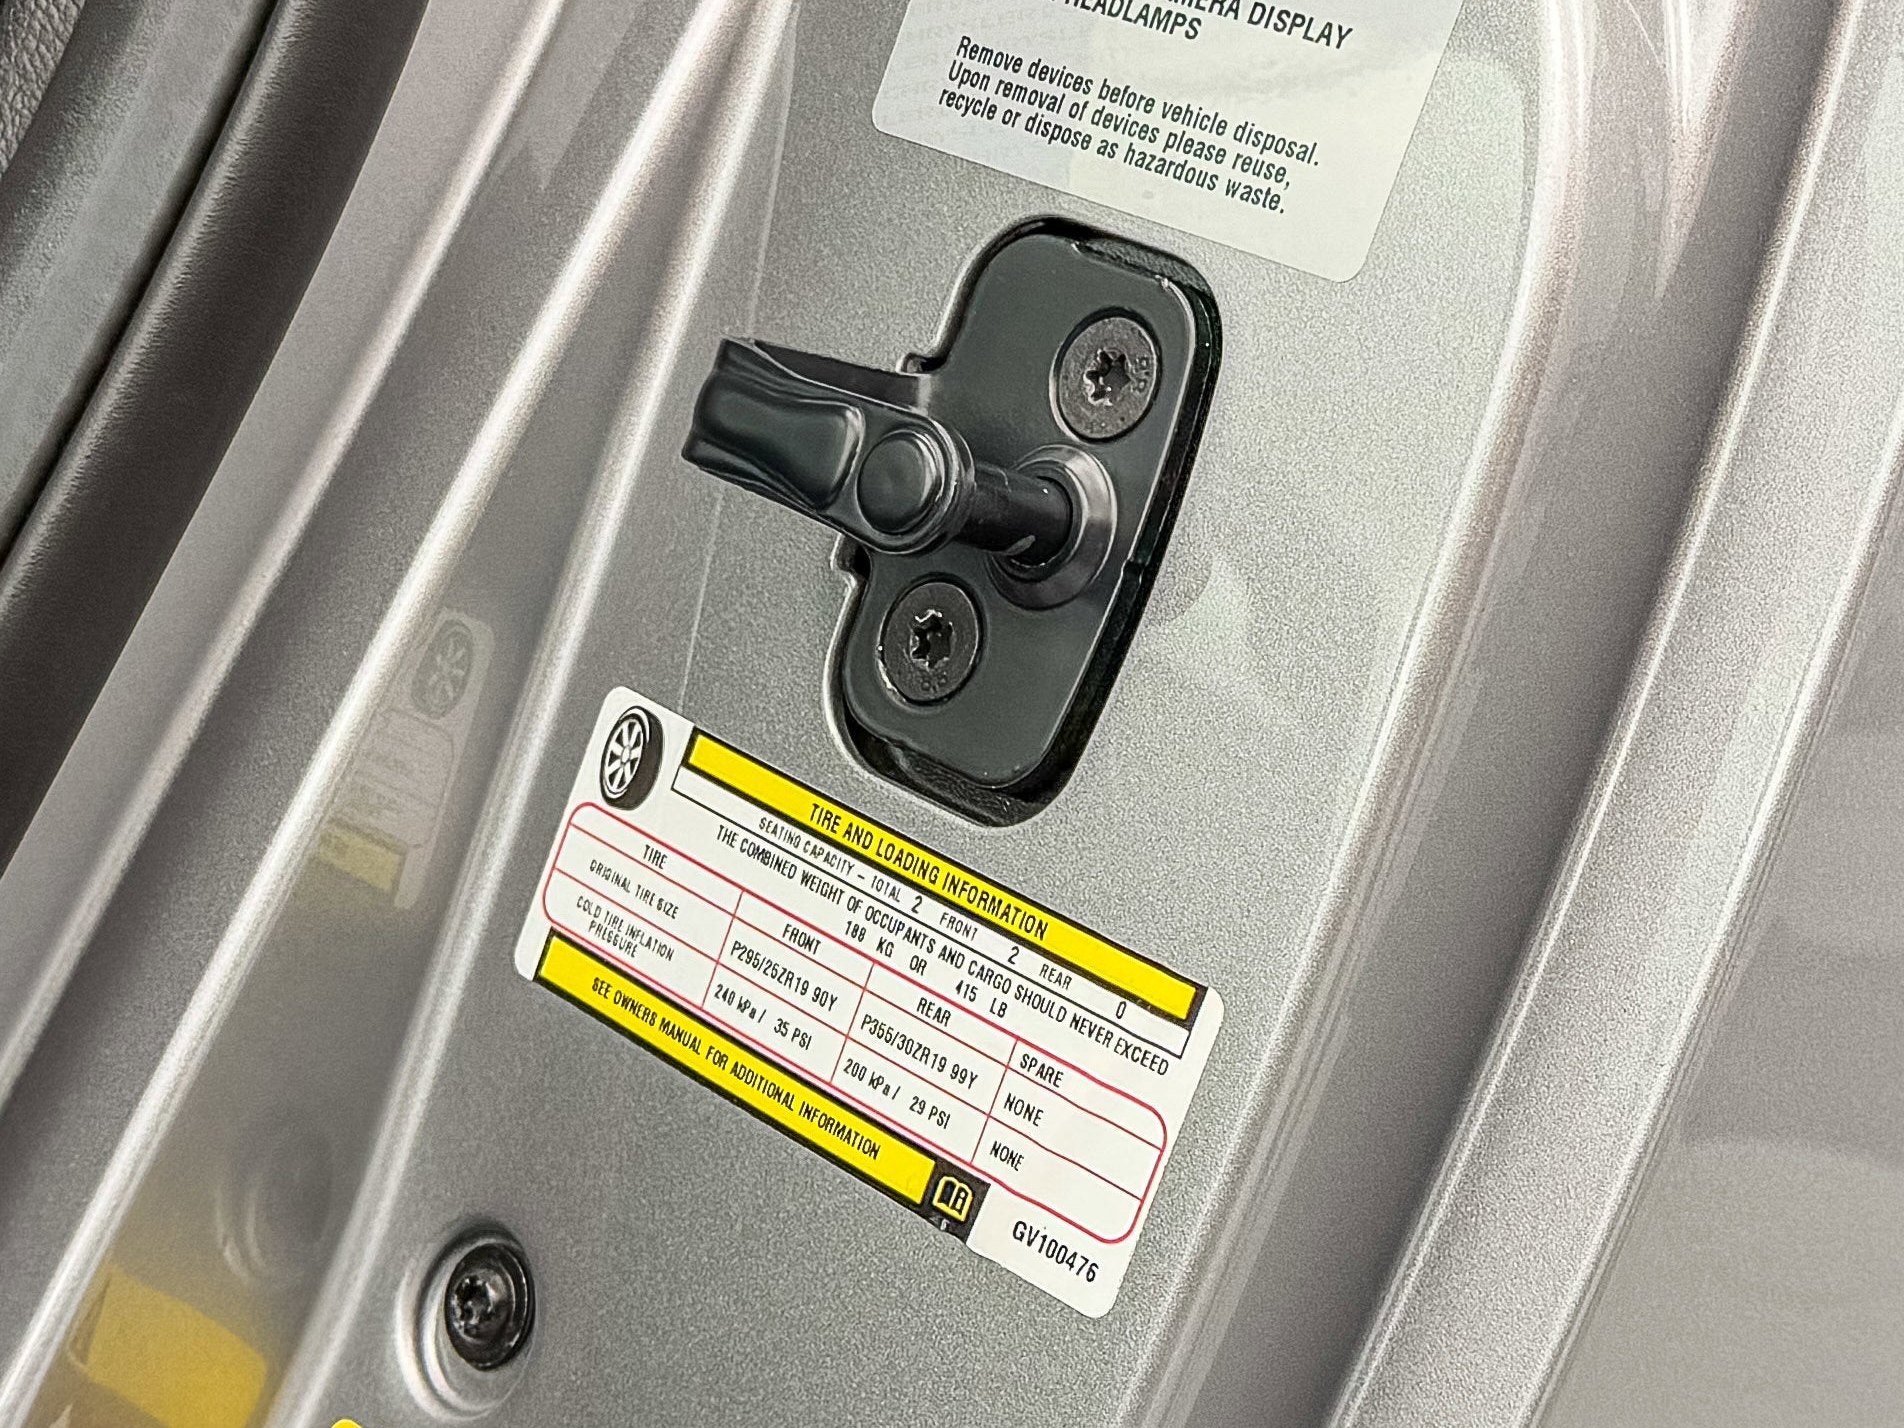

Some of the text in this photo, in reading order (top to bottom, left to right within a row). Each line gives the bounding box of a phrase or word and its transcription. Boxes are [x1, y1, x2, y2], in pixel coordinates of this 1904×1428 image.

[1245, 0, 1354, 50] DISPLAY
[947, 58, 1290, 191] Upon removal of devices please reuse,
[955, 34, 1319, 167] Remove devices before vehicle disposal.
[937, 87, 1285, 214] recycle or dispose as hazardous waste.
[642, 843, 668, 870] TIRE
[808, 801, 1049, 941] TIRE AND LOADING INFORMATION
[588, 858, 679, 920] ORIGINAL TIRE SIZE
[757, 815, 802, 849] SEATING
[801, 839, 856, 876] CAPACITY
[869, 874, 901, 903] TOTAL
[909, 894, 923, 915] 2
[938, 910, 978, 941] FRONT
[1006, 944, 1020, 965] 2
[1037, 962, 1073, 991] REAR
[575, 894, 675, 962] COLD TIRE INFLATION
[587, 918, 638, 958] PRESSURE
[715, 823, 1169, 1076] THE COMBINED WEIGHT OF OCCUPANTS AND CARGO SHOULD NEVER EXCEED
[781, 922, 822, 955] FRONT
[810, 985, 839, 1012] 90Y
[874, 935, 895, 958] KG
[908, 953, 928, 977] OR
[954, 978, 979, 1003] 415
[988, 996, 1008, 1019] LB
[712, 982, 736, 1006] 240
[772, 1016, 790, 1038] 35
[789, 1026, 813, 1051] PSI
[915, 995, 952, 1027] REAR
[590, 975, 881, 1161] SEE OWNERS MANUAL FOR ADDITIONAL INFORMATION
[842, 1057, 868, 1082] 200
[907, 1094, 927, 1116] 29
[926, 1104, 951, 1130] PSI
[948, 1062, 979, 1090] 99Y
[1018, 1052, 1064, 1088] SPARE
[1002, 1091, 1044, 1127] NONE
[988, 1139, 1025, 1172] NONE
[1011, 1219, 1099, 1283] GV100476
